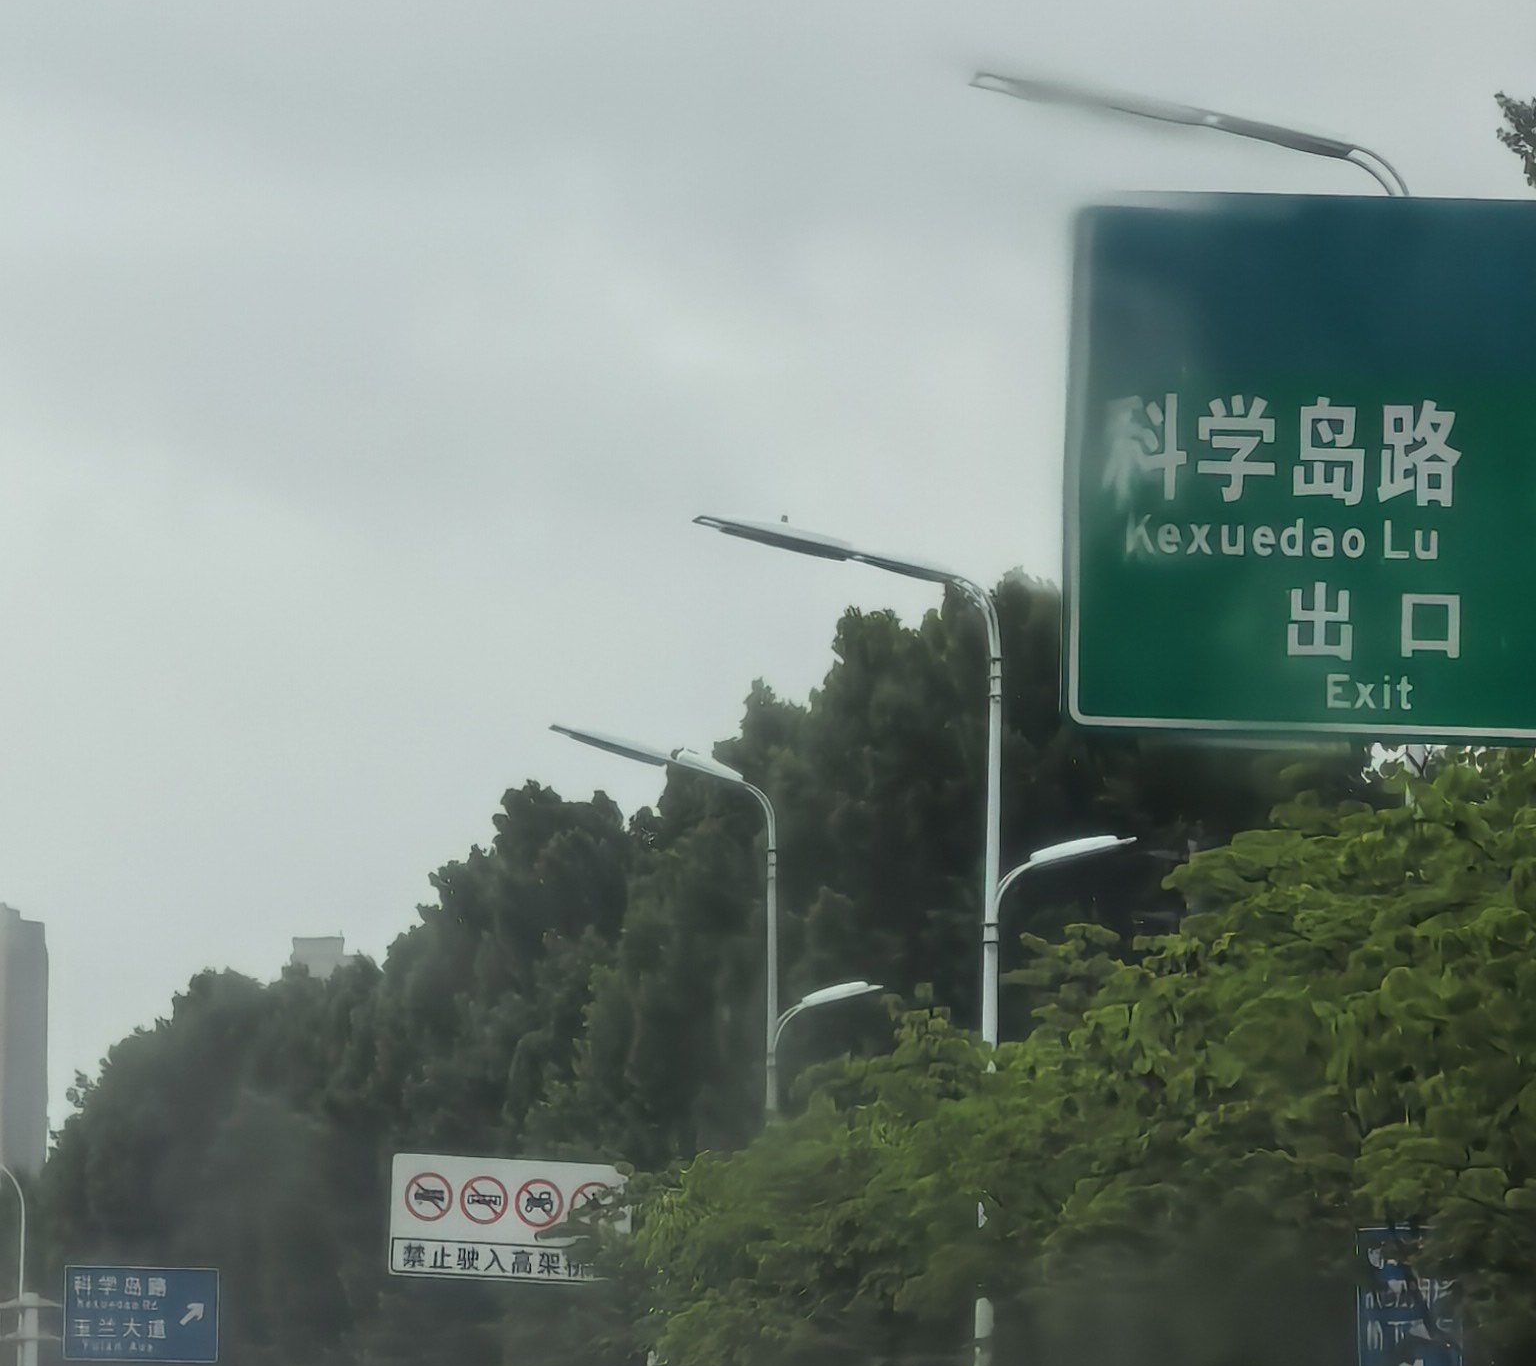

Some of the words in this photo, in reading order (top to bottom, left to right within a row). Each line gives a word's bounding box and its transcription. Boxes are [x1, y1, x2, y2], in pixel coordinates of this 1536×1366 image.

[1103, 393, 1462, 507] 科学岛路
[1126, 515, 1366, 559] Kexuedao
[1384, 519, 1438, 560] Lu
[1287, 581, 1461, 660] 出口
[1326, 673, 1414, 711] Exit
